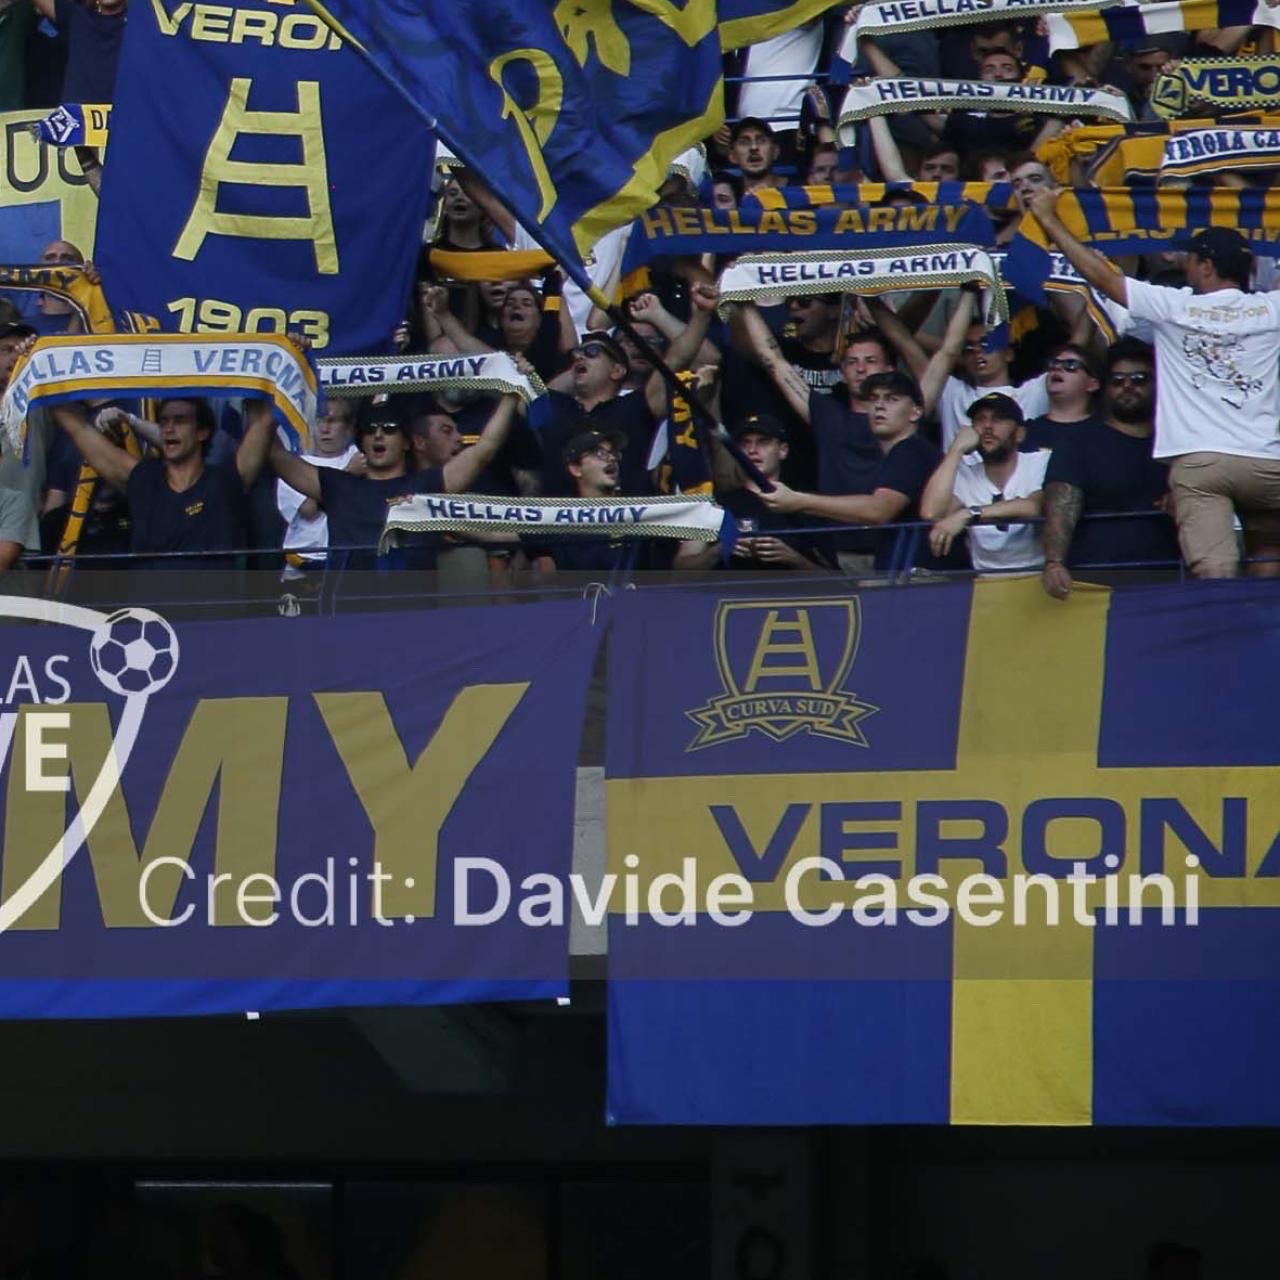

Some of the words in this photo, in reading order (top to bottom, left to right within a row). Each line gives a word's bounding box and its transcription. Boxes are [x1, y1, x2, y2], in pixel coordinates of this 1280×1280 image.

[877, 81, 993, 102] HELLAS
[1006, 83, 1096, 105] ARMY
[1181, 65, 1280, 98] VERO
[643, 207, 818, 238] HELLAS
[835, 204, 969, 235] ARMY
[756, 260, 876, 286] HELLAS
[888, 249, 981, 274] ARMY
[167, 297, 330, 350] 1903
[11, 348, 116, 415] HELLAS
[194, 348, 309, 412] VERONA
[396, 357, 486, 381] ARMY
[428, 499, 544, 521] HELLAS
[554, 505, 648, 523] ARMY
[726, 698, 799, 719] CURVA
[802, 699, 837, 716] SUD
